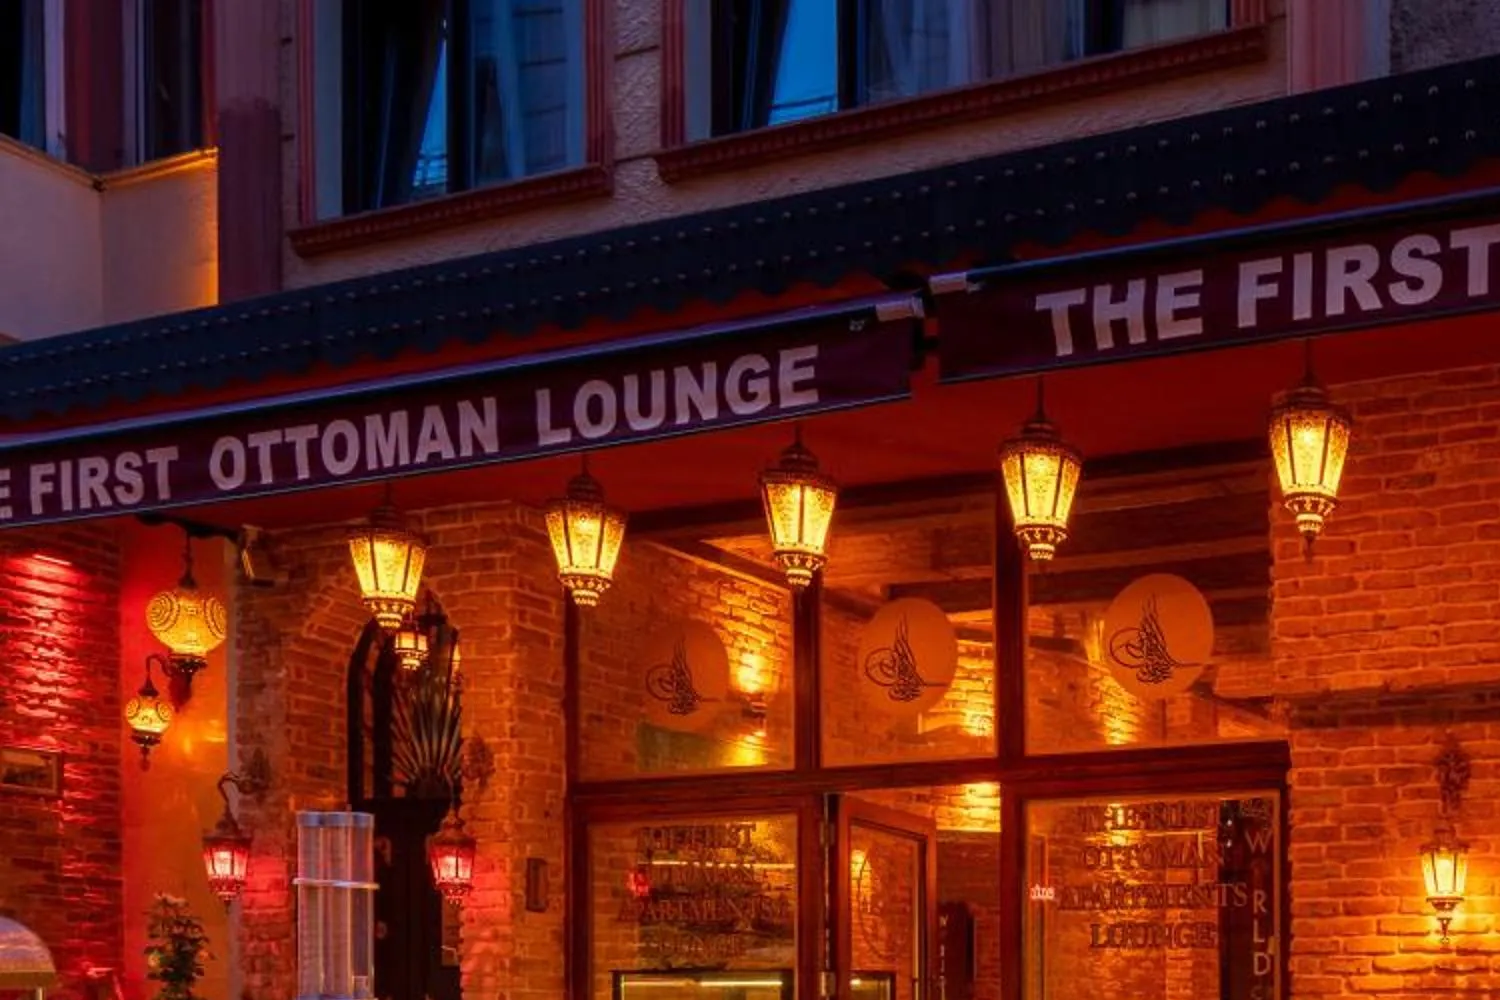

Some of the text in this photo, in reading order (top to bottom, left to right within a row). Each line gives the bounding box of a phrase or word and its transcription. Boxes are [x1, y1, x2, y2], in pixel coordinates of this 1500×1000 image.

[1035, 269, 1204, 357] THE
[29, 446, 180, 515] FIRST
[209, 397, 499, 491] OTTOMAN
[535, 345, 820, 446] LOUNGE
